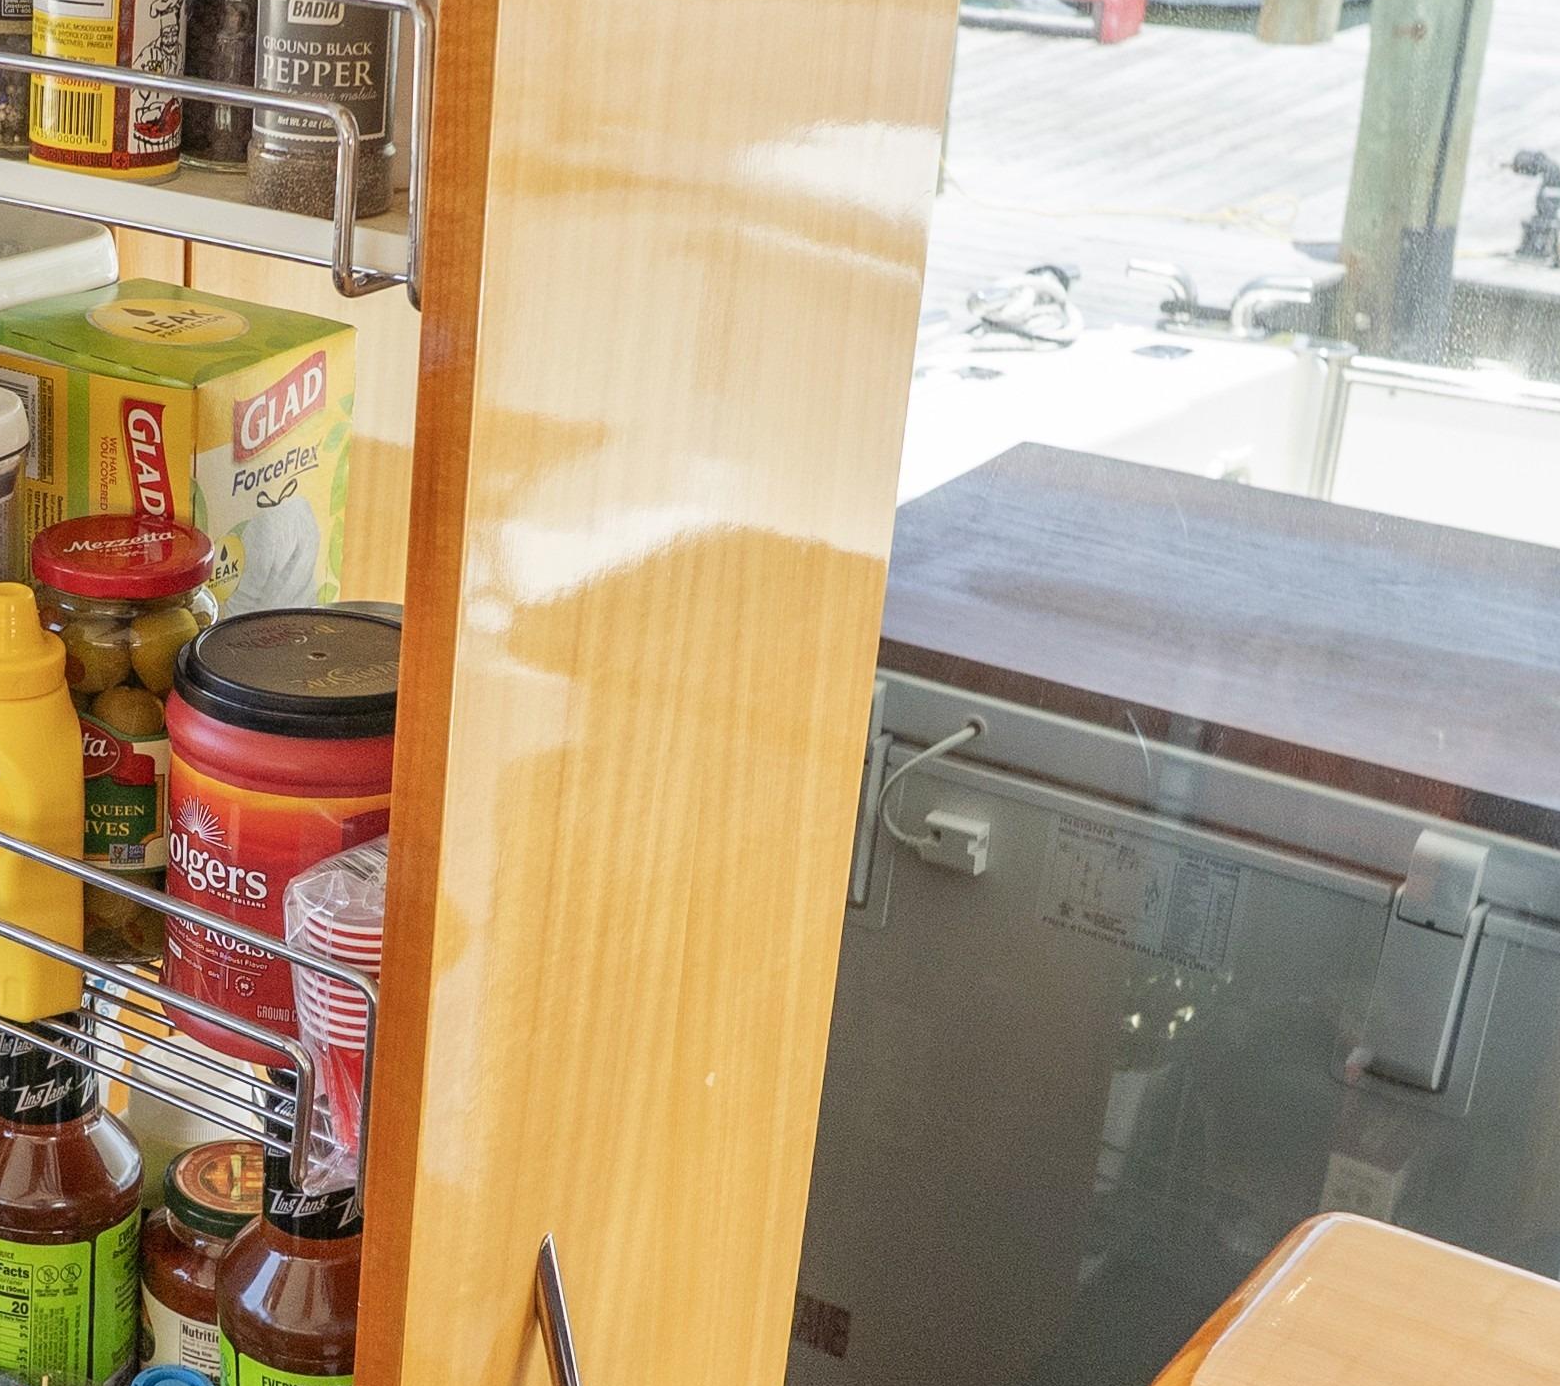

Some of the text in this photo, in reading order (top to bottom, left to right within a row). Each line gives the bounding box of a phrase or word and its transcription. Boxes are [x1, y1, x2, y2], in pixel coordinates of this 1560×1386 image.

[292, 0, 340, 19] BADIA
[263, 35, 373, 56] GROUND BLACK
[262, 54, 374, 87] PEPPER
[302, 119, 308, 127] 2
[134, 310, 213, 336] LEAK
[159, 315, 226, 339] PROTECTION
[240, 365, 323, 451] GLAD
[99, 435, 109, 511] YOU COVERED
[109, 437, 117, 486] WE HAVE
[128, 408, 166, 516] GLAD
[232, 444, 318, 497] ForceFlex
[63, 530, 176, 553] Mezzetta
[90, 804, 146, 818] QUEEN
[169, 832, 269, 900] olgers
[233, 897, 267, 910] ORLEANS
[256, 1005, 290, 1022] GROUND
[11, 1301, 29, 1315] 20
